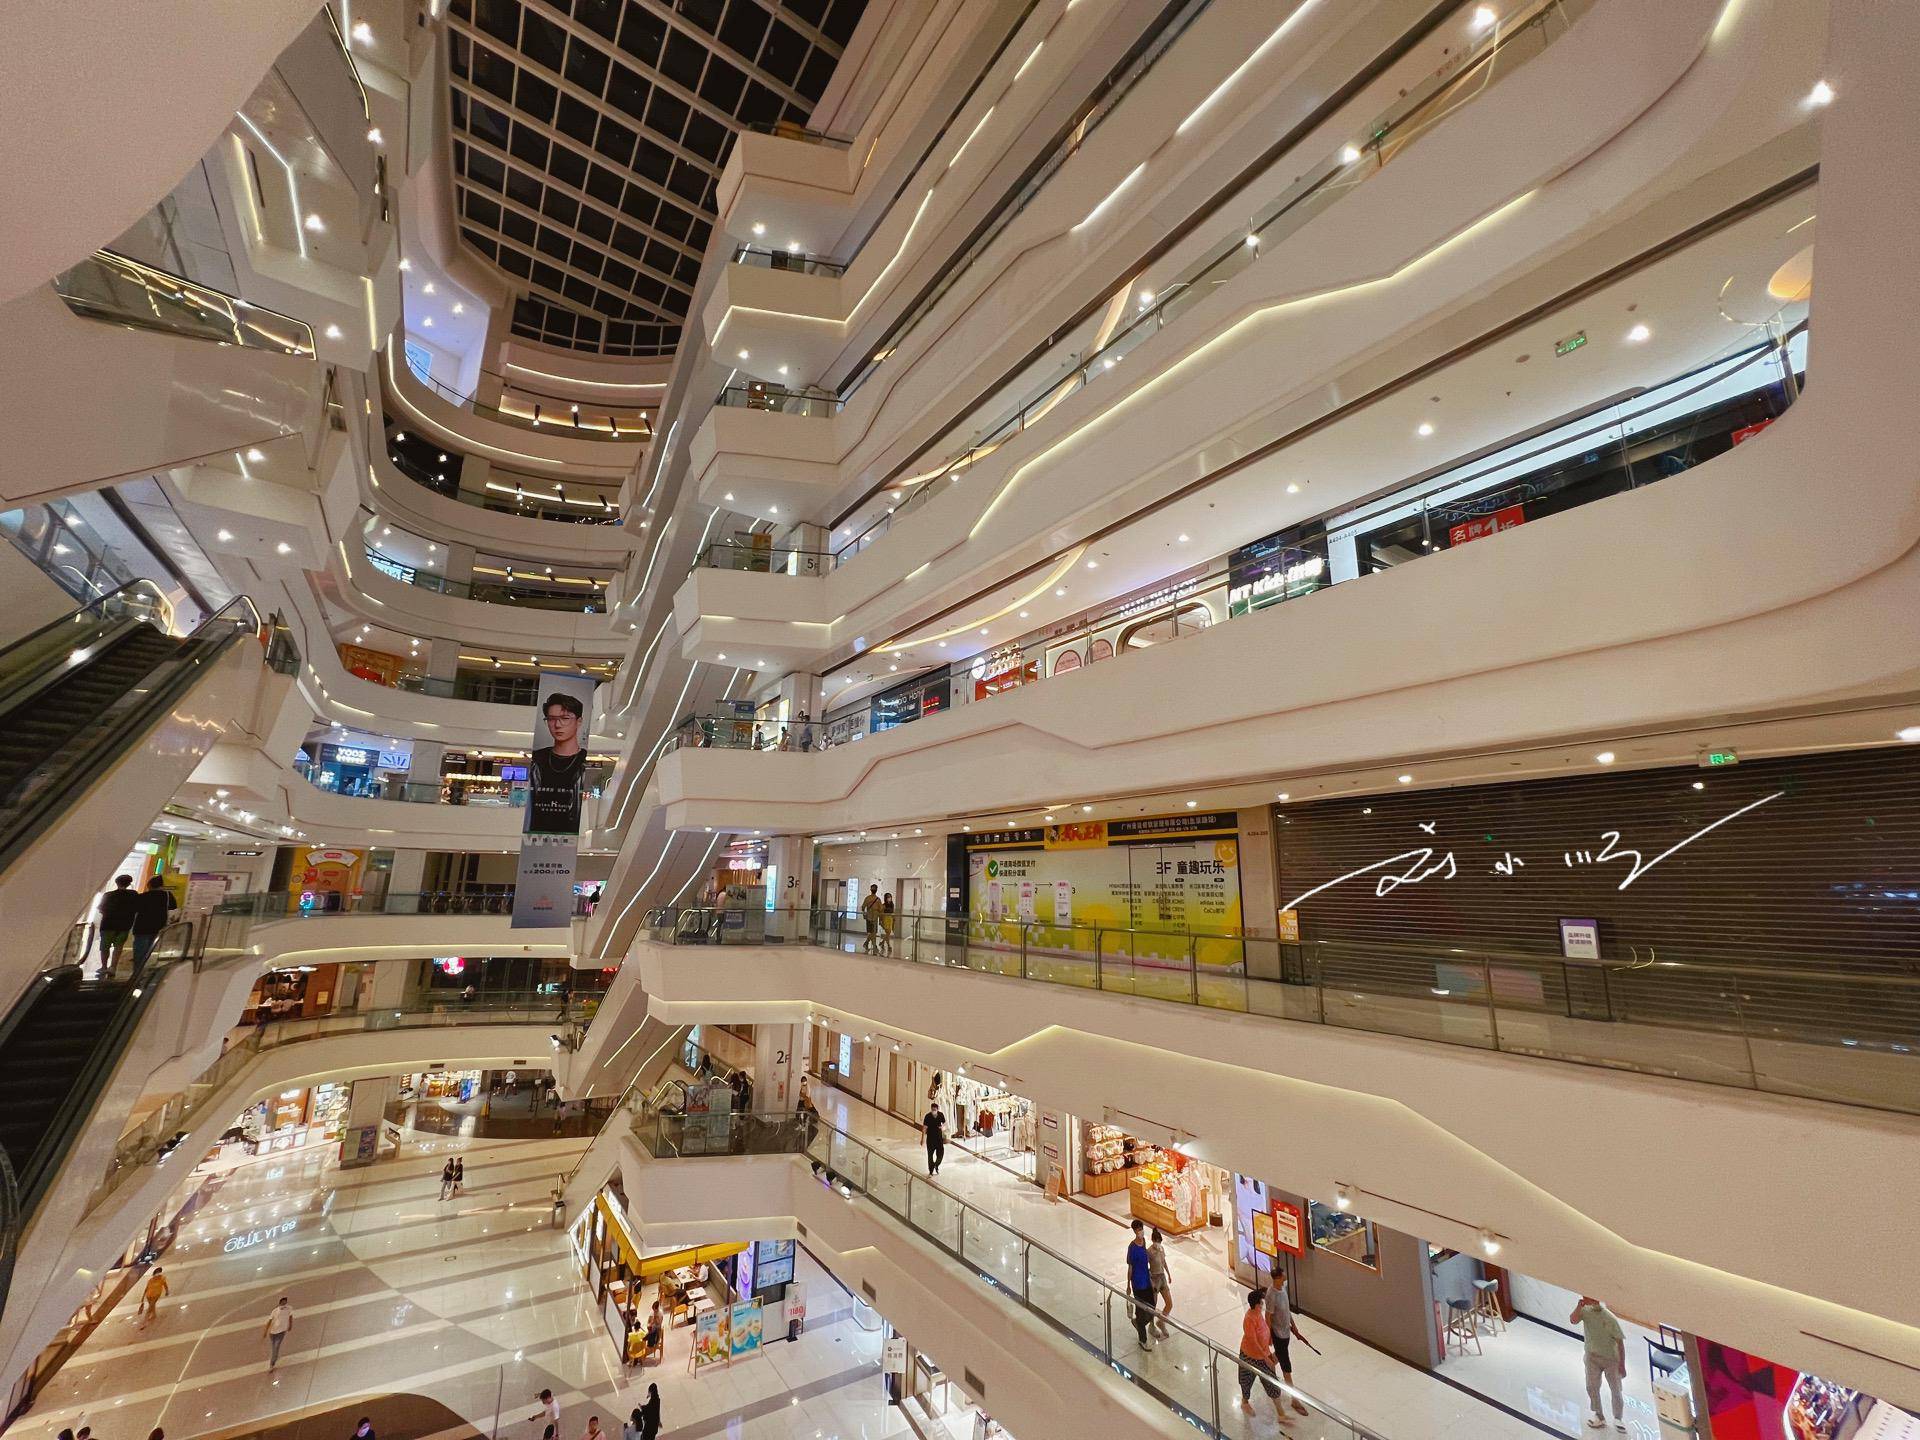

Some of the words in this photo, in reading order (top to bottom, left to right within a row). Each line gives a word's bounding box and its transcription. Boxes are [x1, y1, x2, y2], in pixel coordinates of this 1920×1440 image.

[1156, 861, 1172, 875] 3F
[1176, 860, 1225, 875] 童趣玩乐
[787, 875, 801, 889] 3F
[776, 1050, 791, 1065] 2F
